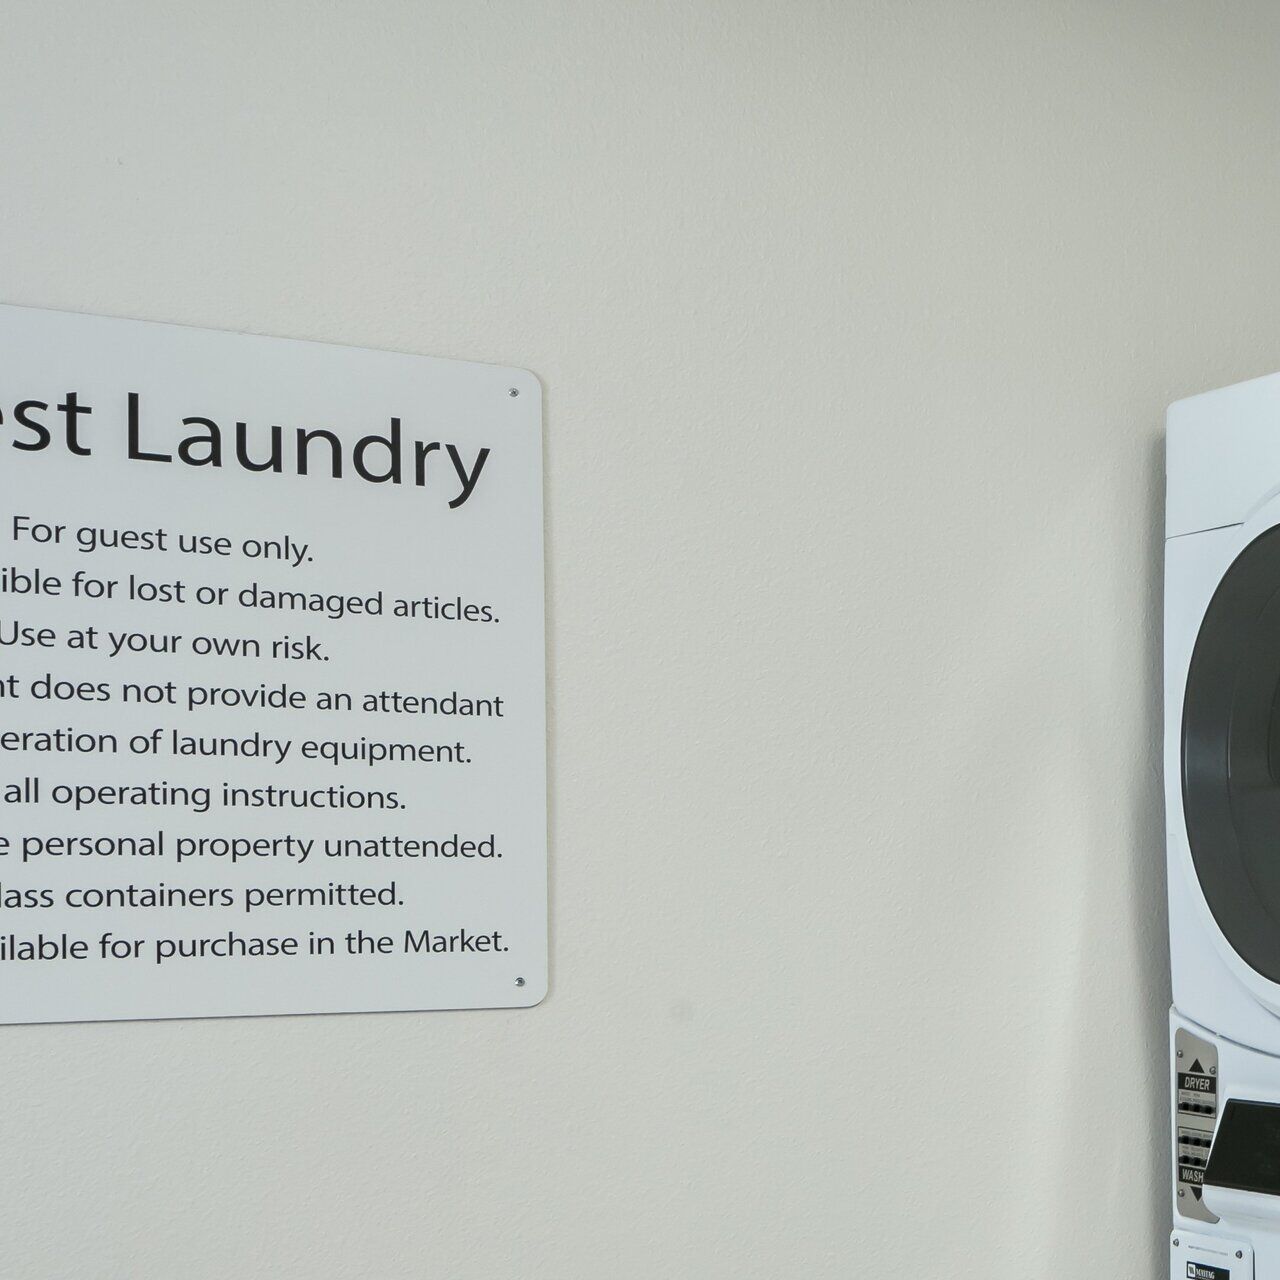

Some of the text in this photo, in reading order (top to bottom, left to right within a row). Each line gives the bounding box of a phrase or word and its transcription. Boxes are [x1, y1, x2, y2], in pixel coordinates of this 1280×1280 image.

[0, 392, 490, 509] st Laundry
[13, 516, 314, 568] For guest use only.
[1, 567, 500, 624] ible for lost or damaged articles.
[0, 621, 330, 662] Use at your own risk.
[30, 673, 111, 702] does
[123, 682, 177, 705] not
[188, 684, 307, 712] provide
[317, 693, 352, 711] an
[363, 690, 505, 718] attendant
[1, 728, 472, 767] eration of laundry equipment.
[4, 777, 406, 813] all operating instructions.
[23, 831, 164, 863] personal
[176, 835, 315, 864] property
[325, 834, 503, 859] unattended.
[66, 883, 234, 908] containers
[246, 881, 404, 913] permitted.
[1, 929, 509, 965] ilable for purchase in the Market.
[1185, 1077, 1210, 1090] DRYER
[1182, 1168, 1205, 1183] WASH
